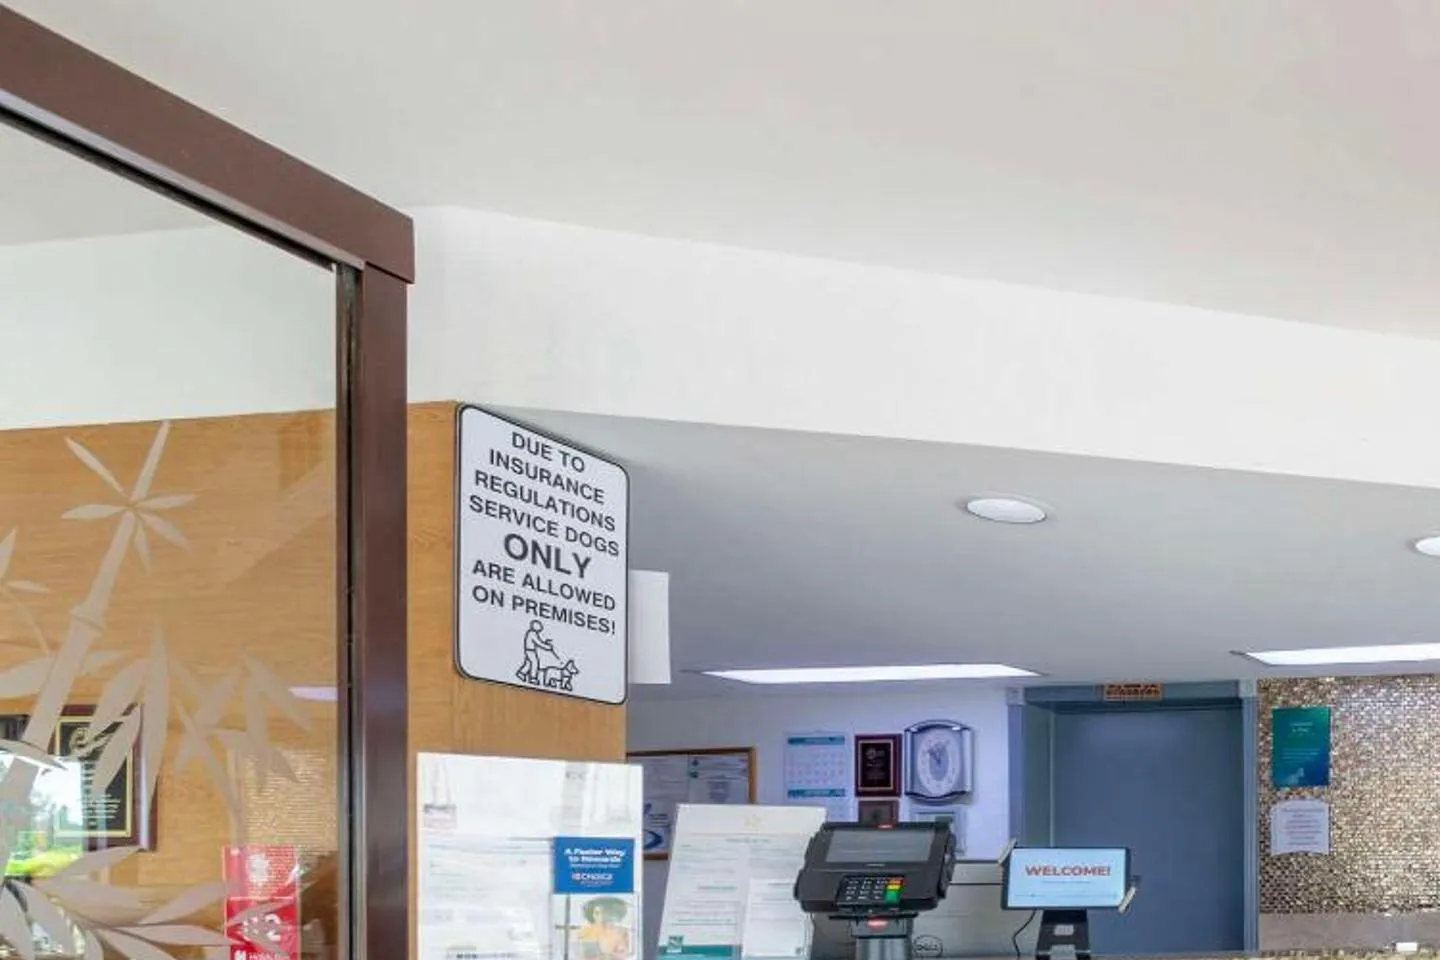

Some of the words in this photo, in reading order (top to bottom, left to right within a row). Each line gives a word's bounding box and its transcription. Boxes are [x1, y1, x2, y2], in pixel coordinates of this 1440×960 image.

[489, 449, 605, 505] INSURANCE
[511, 431, 552, 461] DUE
[557, 450, 585, 473] TO
[469, 494, 559, 537] SERVICE
[565, 524, 620, 557] DOGS
[474, 470, 616, 532] REGULATIONS
[503, 533, 592, 578] ONLY
[472, 560, 515, 585] ARE
[522, 572, 616, 611] ALLOWED
[472, 585, 504, 607] ON
[511, 594, 616, 635] PREMISES!
[1025, 864, 1111, 876] WELCOME!
